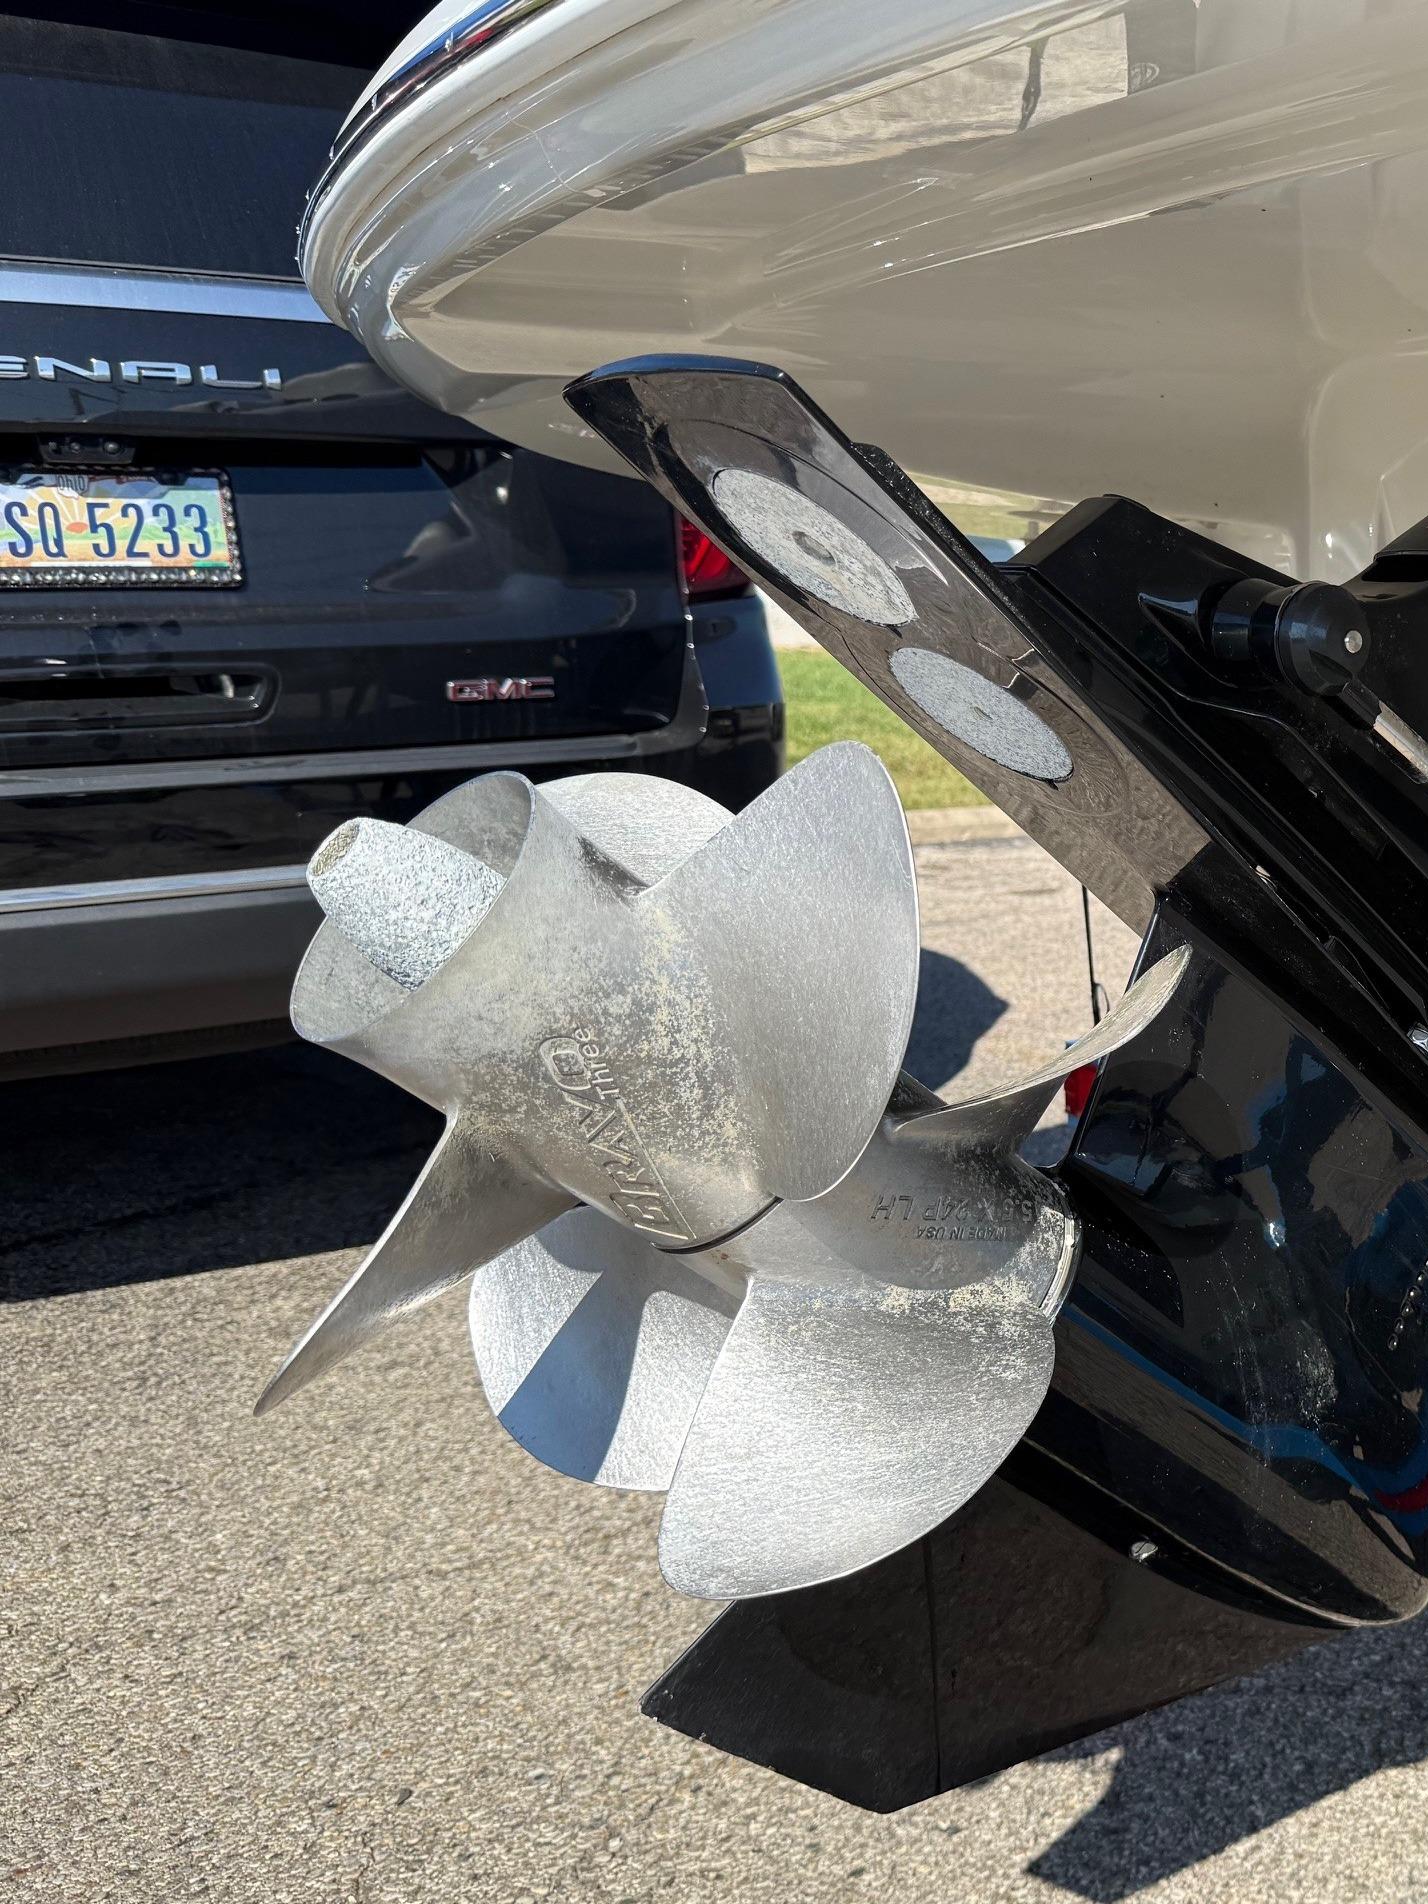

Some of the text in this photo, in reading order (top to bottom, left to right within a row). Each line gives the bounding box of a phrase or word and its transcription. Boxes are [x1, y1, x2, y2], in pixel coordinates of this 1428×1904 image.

[4, 501, 213, 559] SQ 5233
[446, 676, 556, 702] GMC
[573, 1027, 621, 1101] Three
[868, 1194, 914, 1222] LH
[915, 1225, 946, 1241] USA
[950, 1225, 965, 1241] IN
